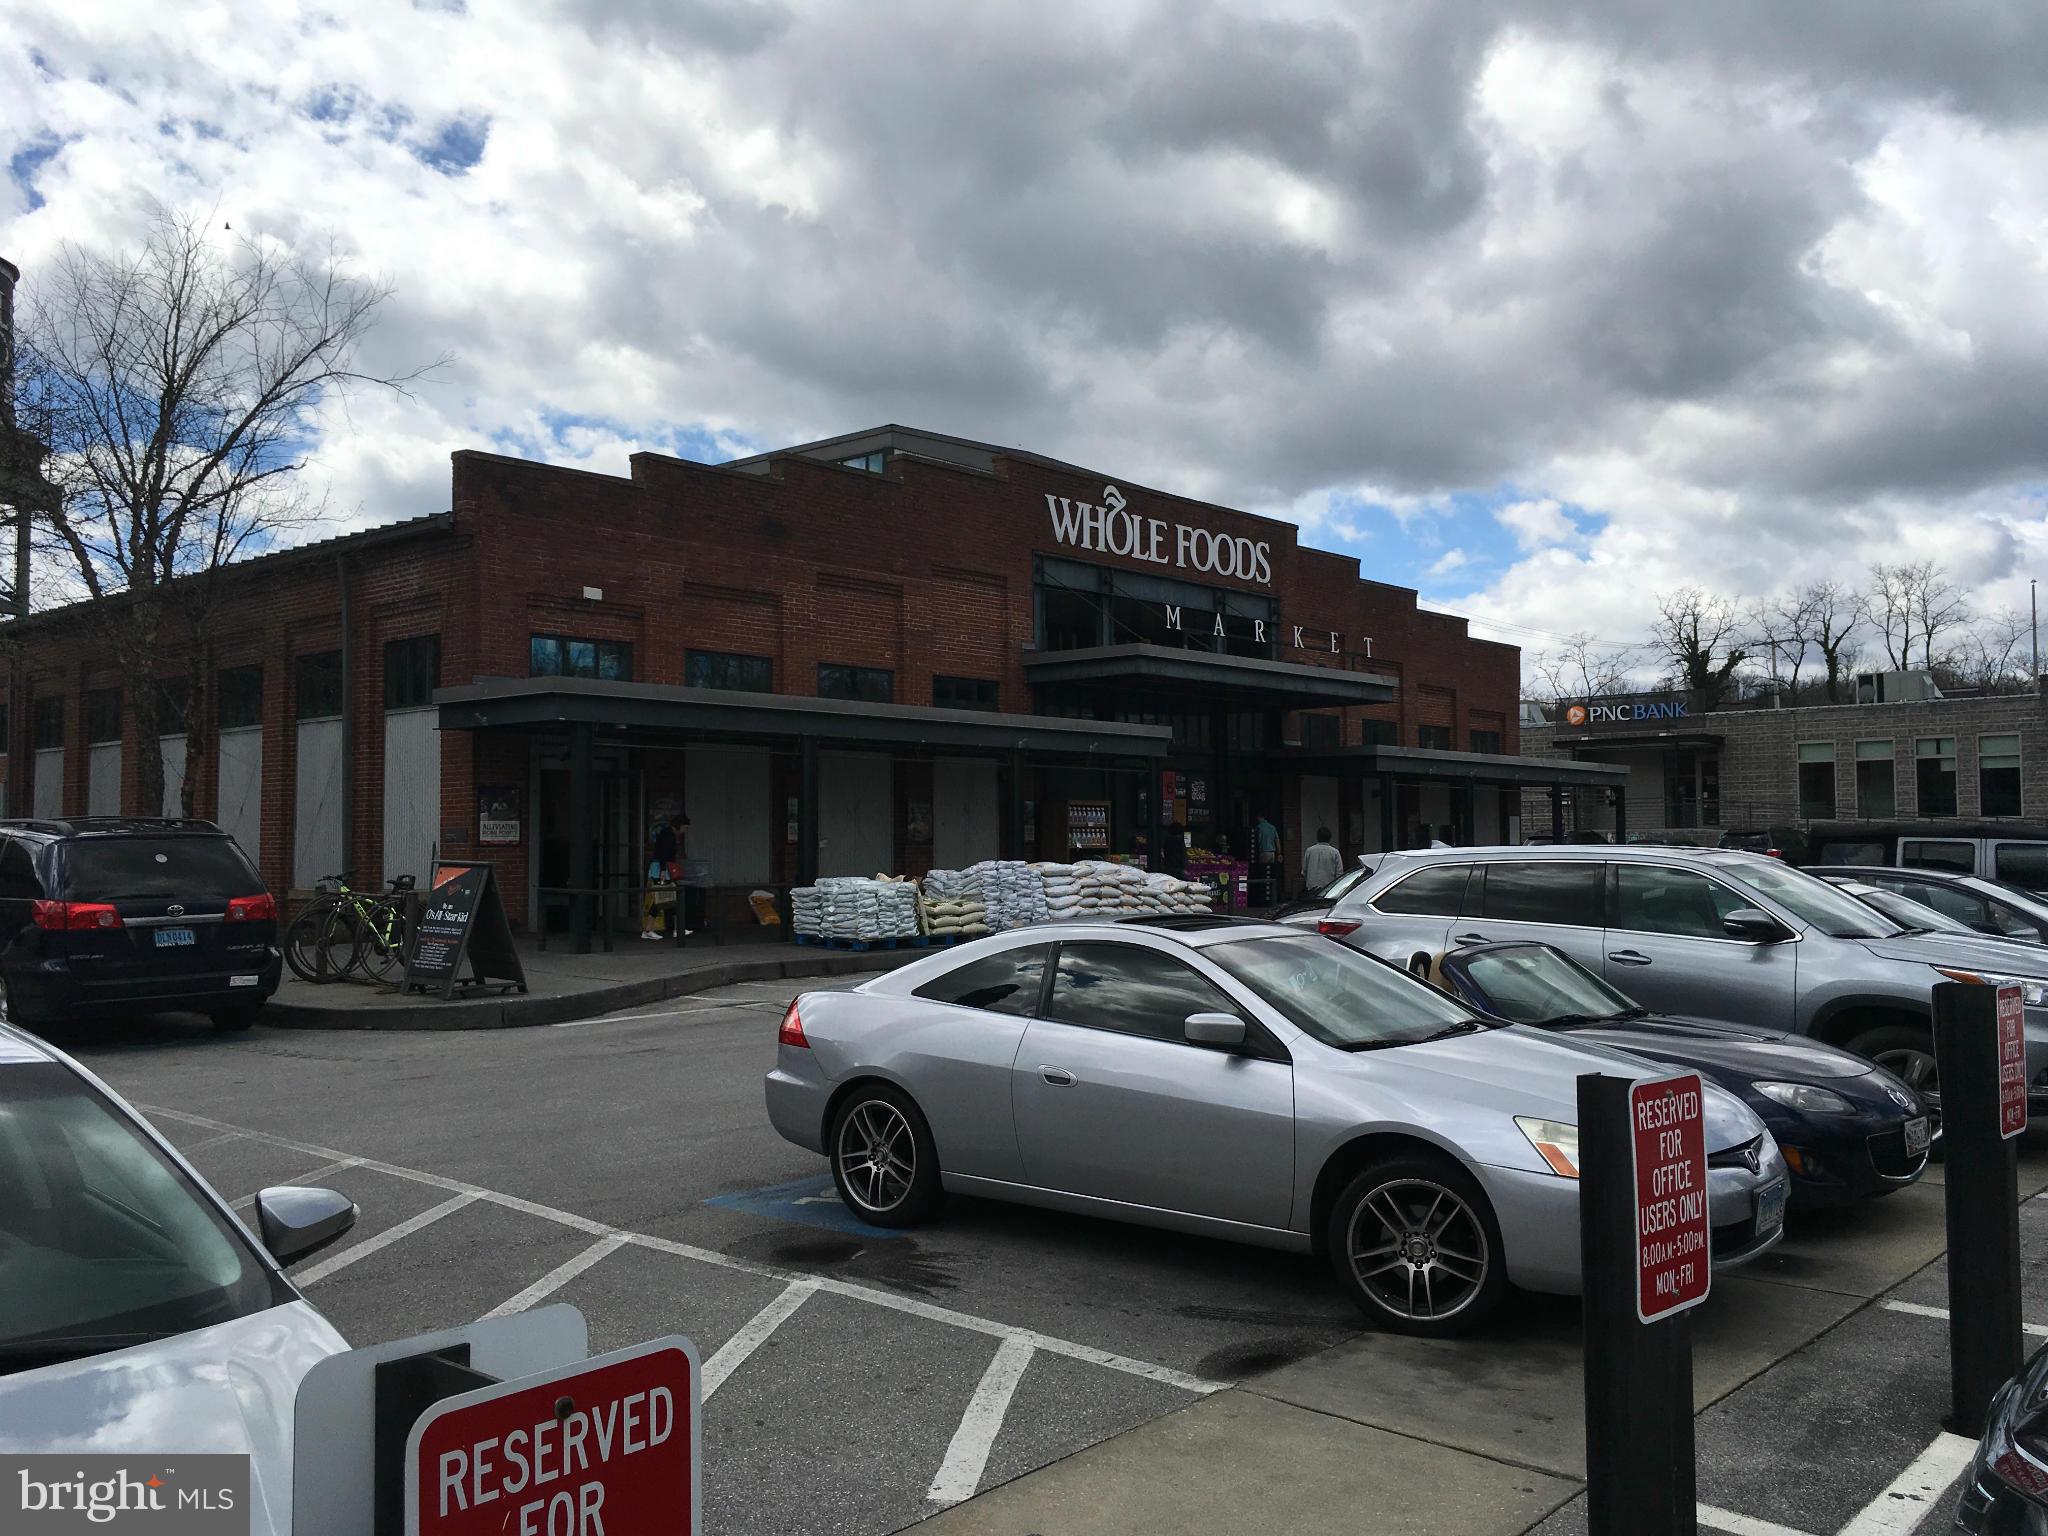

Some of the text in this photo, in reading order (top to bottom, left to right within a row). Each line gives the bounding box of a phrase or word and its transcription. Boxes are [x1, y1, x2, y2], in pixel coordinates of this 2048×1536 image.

[1044, 485, 1272, 587] WHOLE FOODS
[1165, 603, 1375, 658] MARKET
[1588, 702, 1688, 723] PNC BANK
[1637, 1091, 1698, 1131] RESERVED
[1659, 1129, 1683, 1160] FOR
[1652, 1160, 1692, 1198] OFFICE
[1641, 1190, 1704, 1236] USERS ONLY
[439, 1386, 674, 1518] RESERVED
[520, 1480, 606, 1536] FOR
